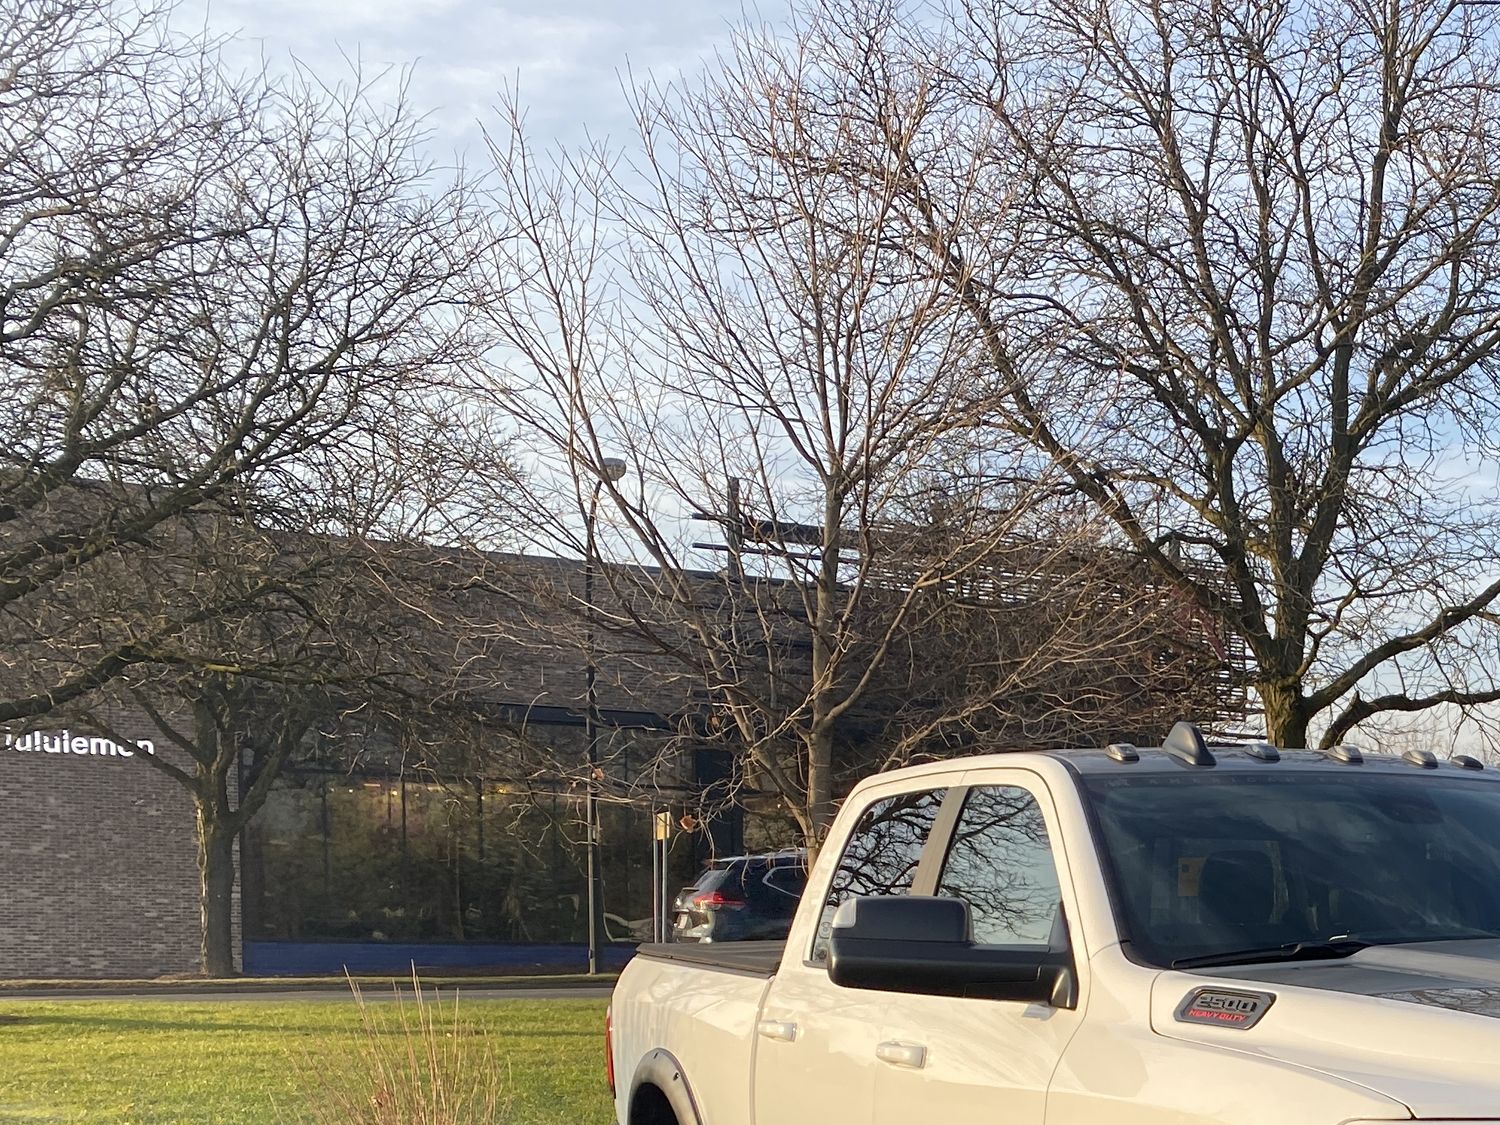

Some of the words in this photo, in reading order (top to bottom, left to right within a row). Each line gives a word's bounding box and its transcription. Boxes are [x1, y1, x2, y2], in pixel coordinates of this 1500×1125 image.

[1197, 994, 1258, 1013] 2500
[1189, 1009, 1219, 1018] HEAVY
[1218, 1012, 1247, 1021] DUTY
